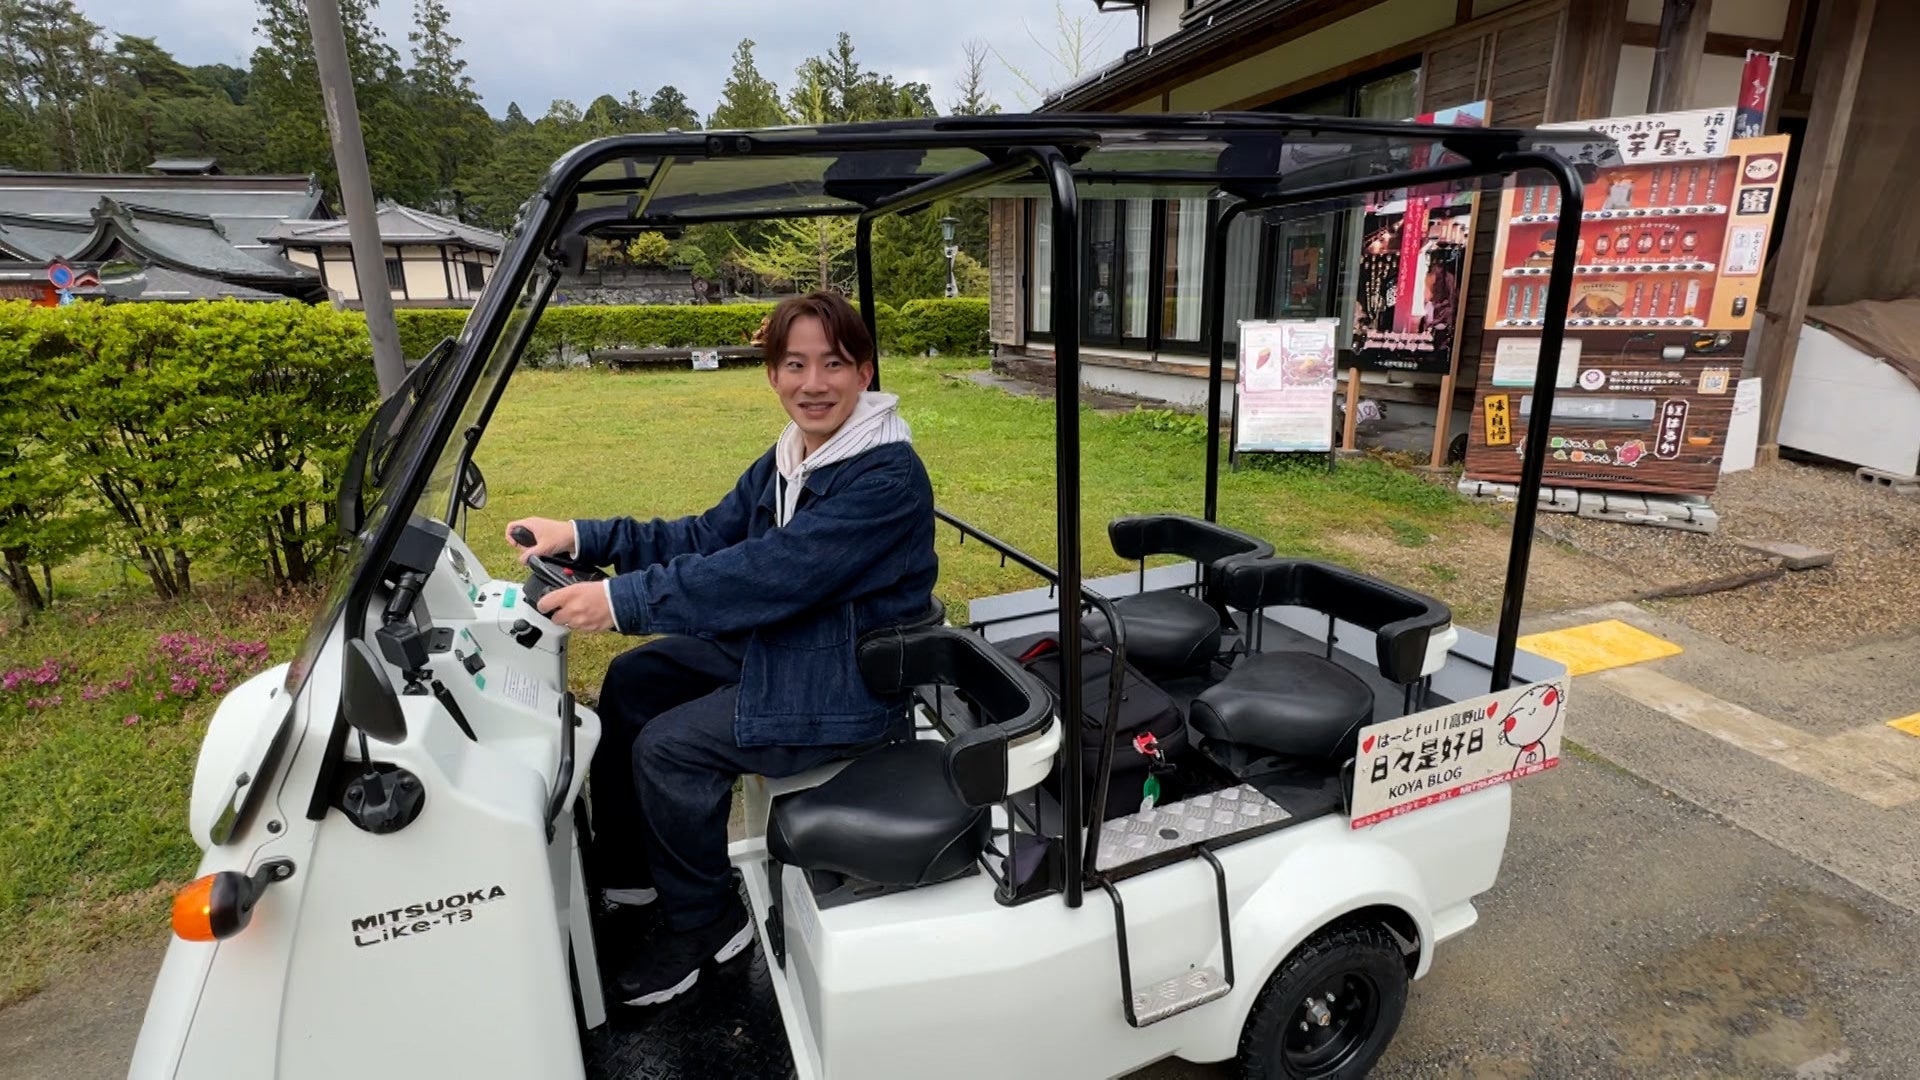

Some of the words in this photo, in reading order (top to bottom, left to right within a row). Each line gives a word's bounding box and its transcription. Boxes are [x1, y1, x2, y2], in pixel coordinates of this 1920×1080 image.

[1627, 128, 1696, 157] 芋屋さん
[1703, 113, 1725, 154] 焼き芋
[1660, 404, 1684, 454] 紅はるか
[1370, 728, 1483, 784] 日々是好日
[1388, 778, 1423, 799] KOYA
[1427, 767, 1463, 788] BLOG
[351, 885, 506, 932] MITSUOKA
[354, 908, 473, 947] Like-T3
